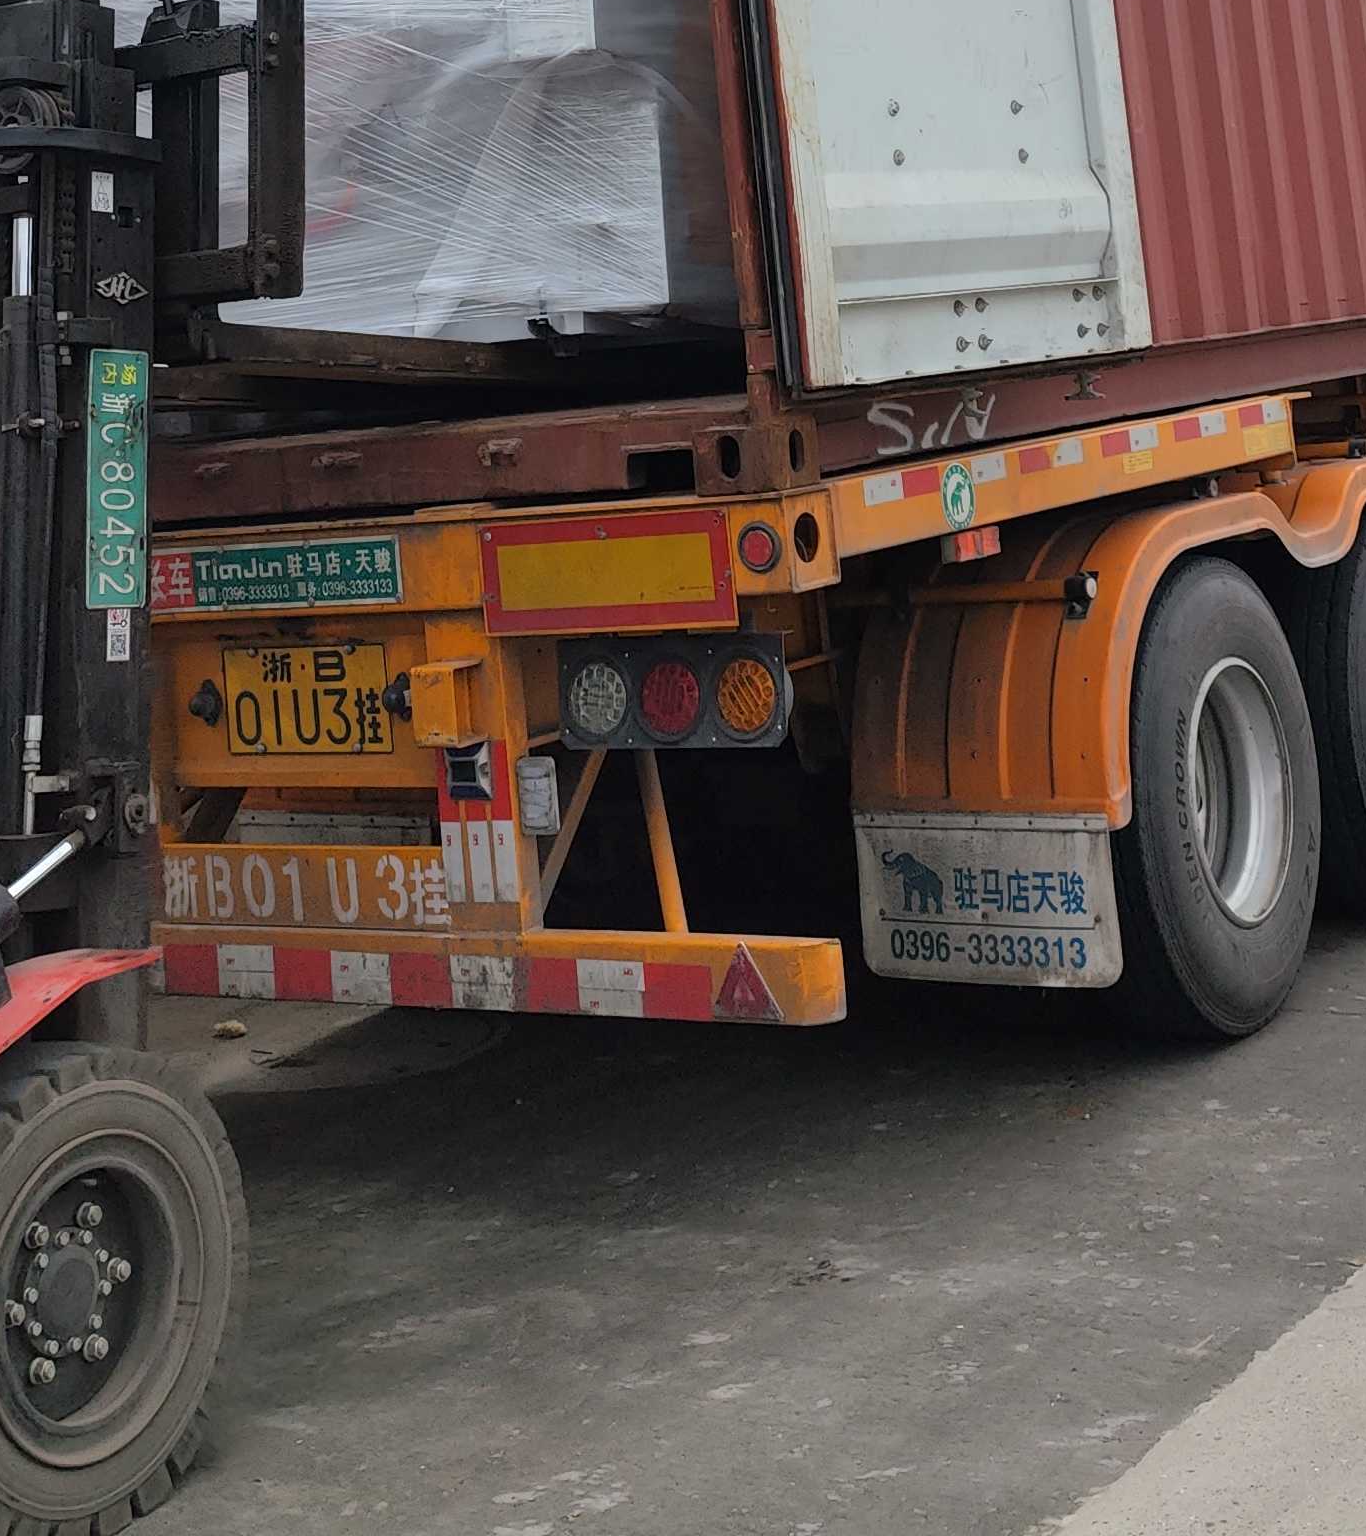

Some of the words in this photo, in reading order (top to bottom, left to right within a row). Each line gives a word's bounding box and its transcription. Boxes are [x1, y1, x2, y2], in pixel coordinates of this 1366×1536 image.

[952, 866, 1088, 915] 驻马店天骏
[890, 928, 1088, 970] 0396-3333313
